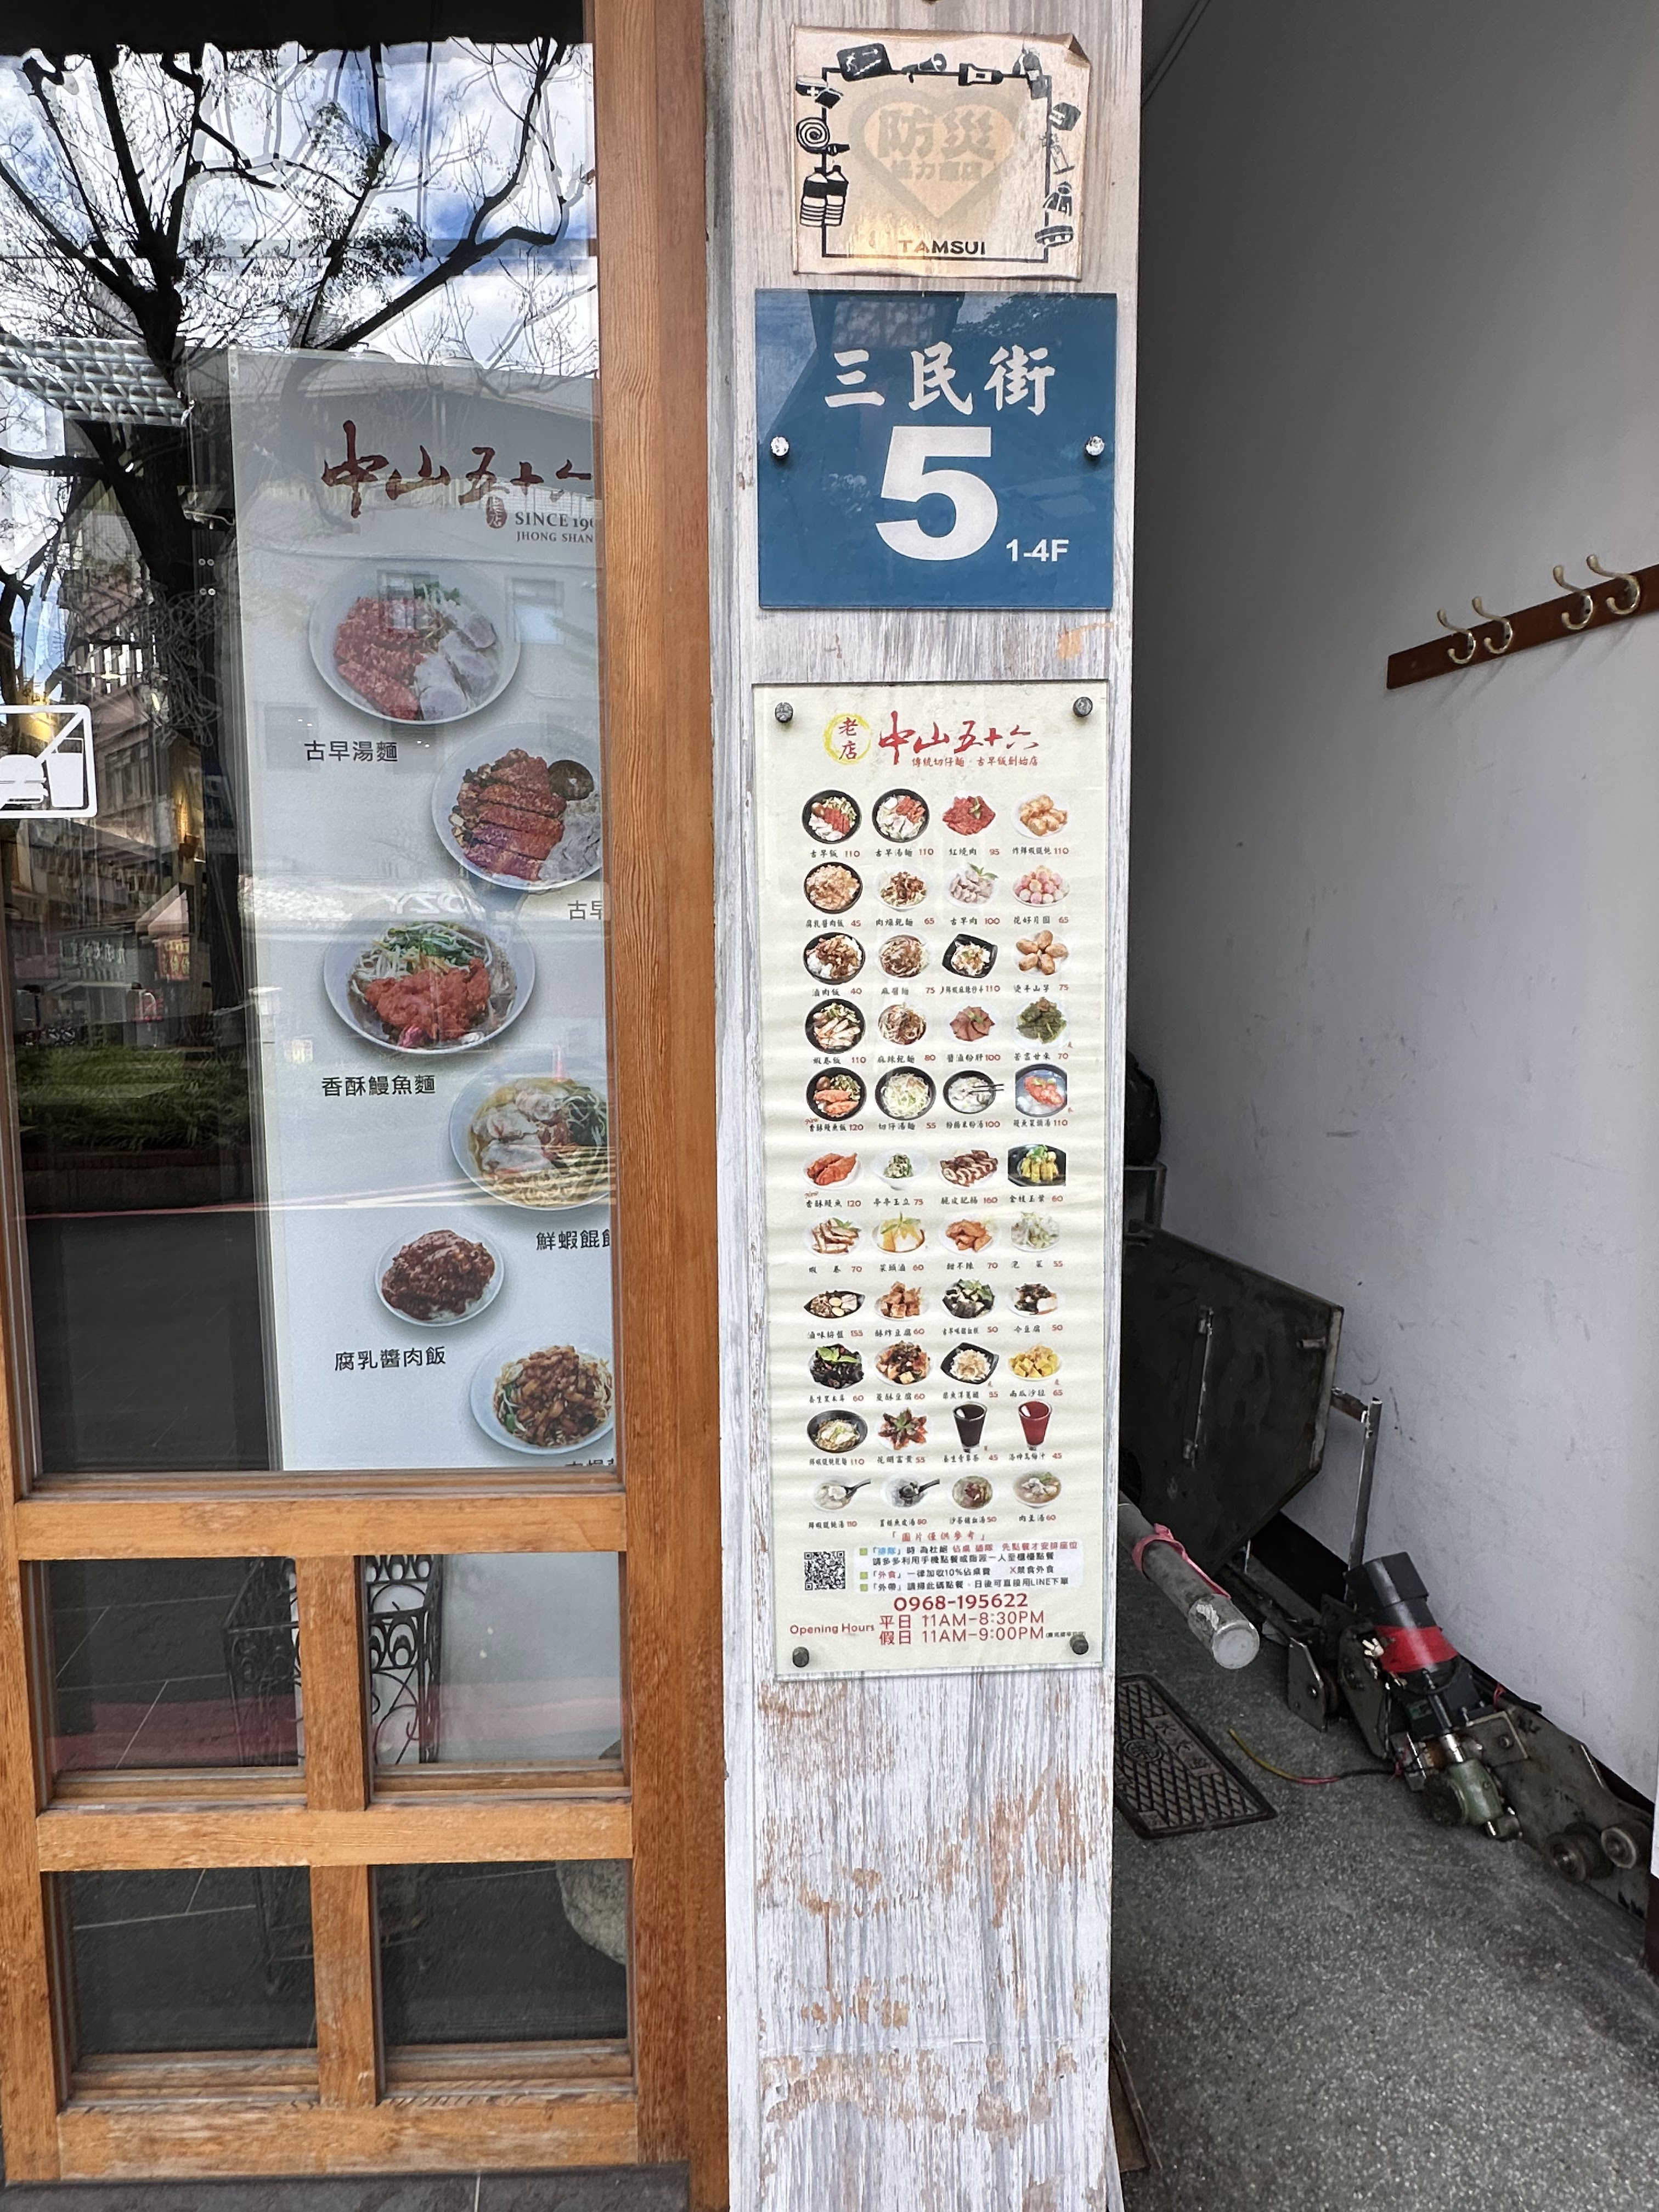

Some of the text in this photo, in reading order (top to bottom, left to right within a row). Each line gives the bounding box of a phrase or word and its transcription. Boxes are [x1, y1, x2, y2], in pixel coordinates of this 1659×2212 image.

[899, 240, 986, 256] TAMSUI
[824, 341, 1056, 415] 三民街
[875, 425, 1069, 562] 5 1-4F
[515, 512, 568, 527] SINCE
[517, 531, 556, 542] JHONG
[838, 717, 859, 760] 老店
[879, 710, 1040, 765] 中山五十六
[304, 740, 398, 762] 古早湯麵
[810, 849, 838, 857] 古早飯
[875, 849, 913, 857] 古早湯麵
[949, 847, 977, 856] 紅燒肉
[950, 917, 977, 926] 古早肉
[321, 1074, 436, 1097] 香酥鰻魚麵
[335, 1346, 447, 1372] 腐乳醬肉飯
[894, 1593, 1028, 1611] 0968-195622
[790, 1623, 874, 1635] Opening Hours
[880, 1611, 1044, 1629] 平日 11AM-8:30PM
[879, 1630, 911, 1645] 假日
[922, 1627, 1043, 1643] 11AM-9:00PM
